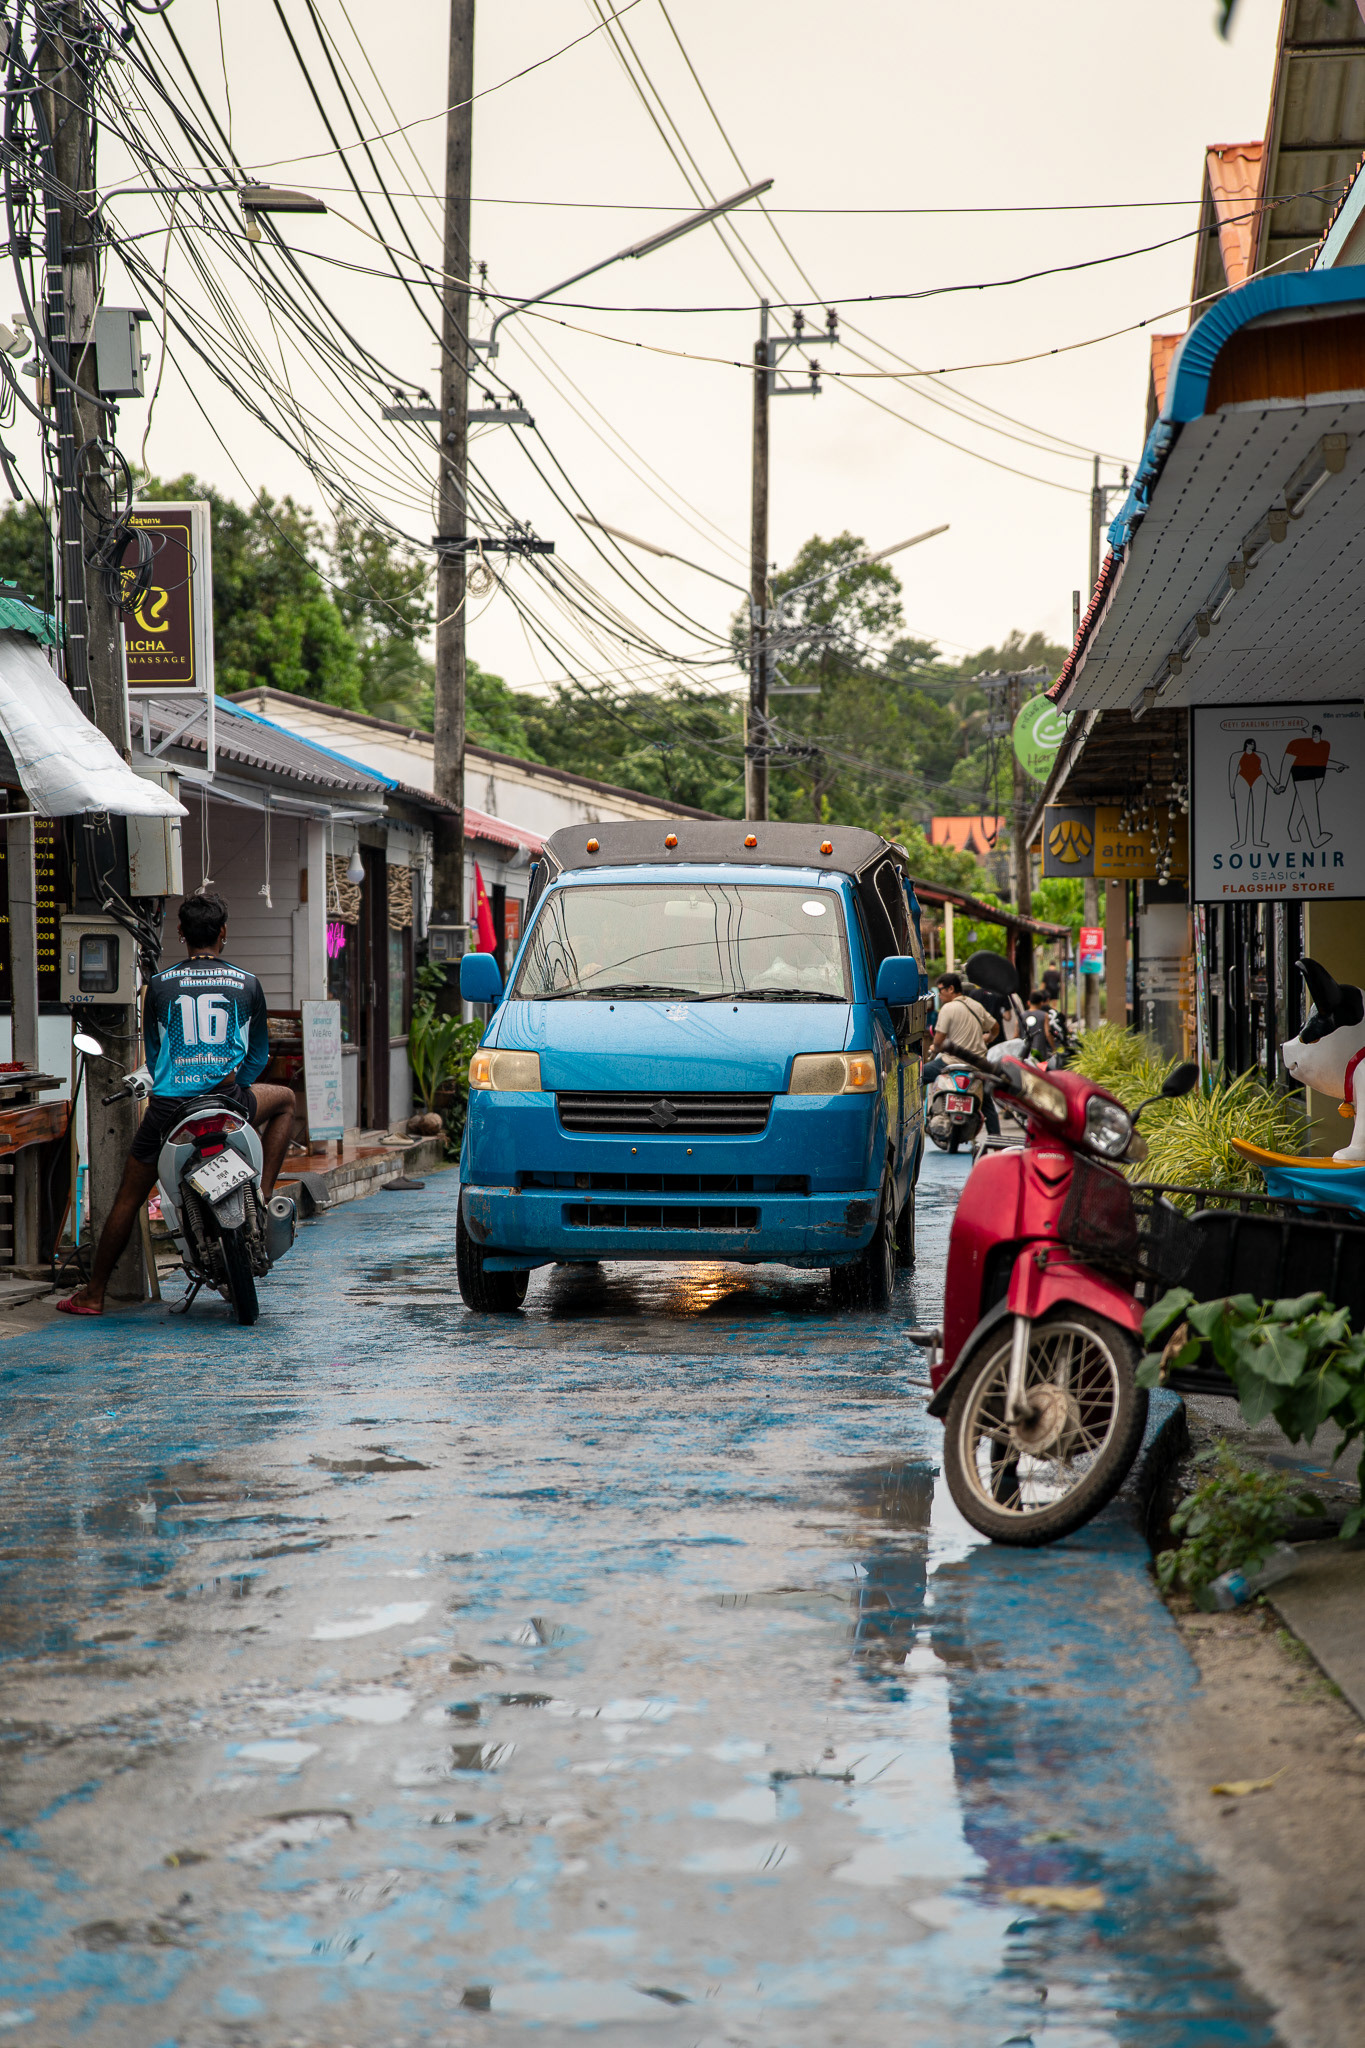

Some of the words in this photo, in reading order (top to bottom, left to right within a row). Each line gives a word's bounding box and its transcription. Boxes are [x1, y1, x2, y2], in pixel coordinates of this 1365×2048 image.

[129, 656, 186, 664] MASSAGE
[1241, 720, 1270, 728] DARLING
[1287, 719, 1304, 727] HERE
[1028, 752, 1057, 767] Har
[1102, 842, 1144, 858] atm
[1213, 851, 1345, 870] SOUVENIR
[1252, 871, 1305, 881] SEASICK
[1223, 883, 1287, 893] FLAGSHIP
[1292, 882, 1335, 892] STORE
[69, 995, 95, 1003] 3047
[174, 993, 231, 1046] 16
[308, 1039, 338, 1055] OPEN
[174, 1074, 201, 1083] KING
[211, 1170, 249, 1197] 7349
